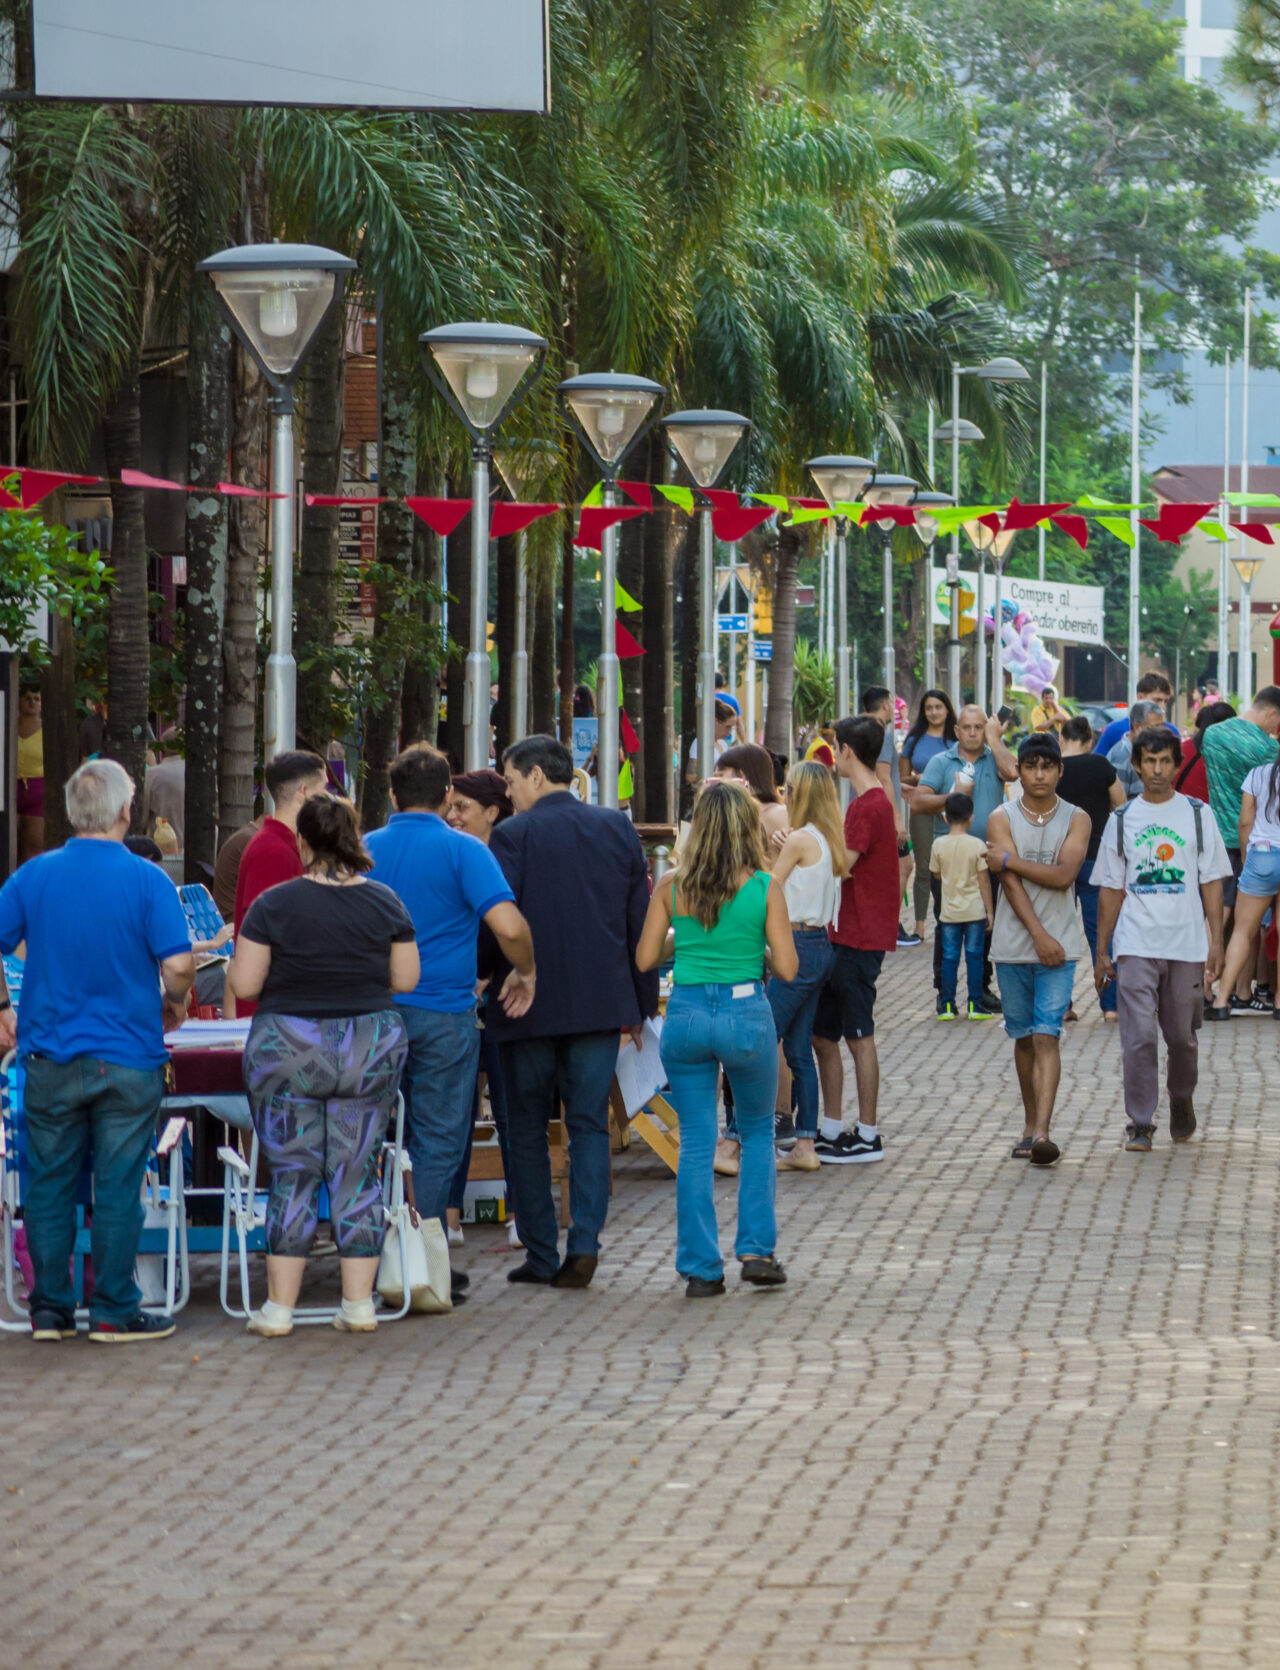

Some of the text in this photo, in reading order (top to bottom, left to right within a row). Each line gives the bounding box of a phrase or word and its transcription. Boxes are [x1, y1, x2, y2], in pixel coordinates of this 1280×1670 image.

[1010, 582, 1070, 607] Compre al
[1058, 615, 1099, 636] obereño
